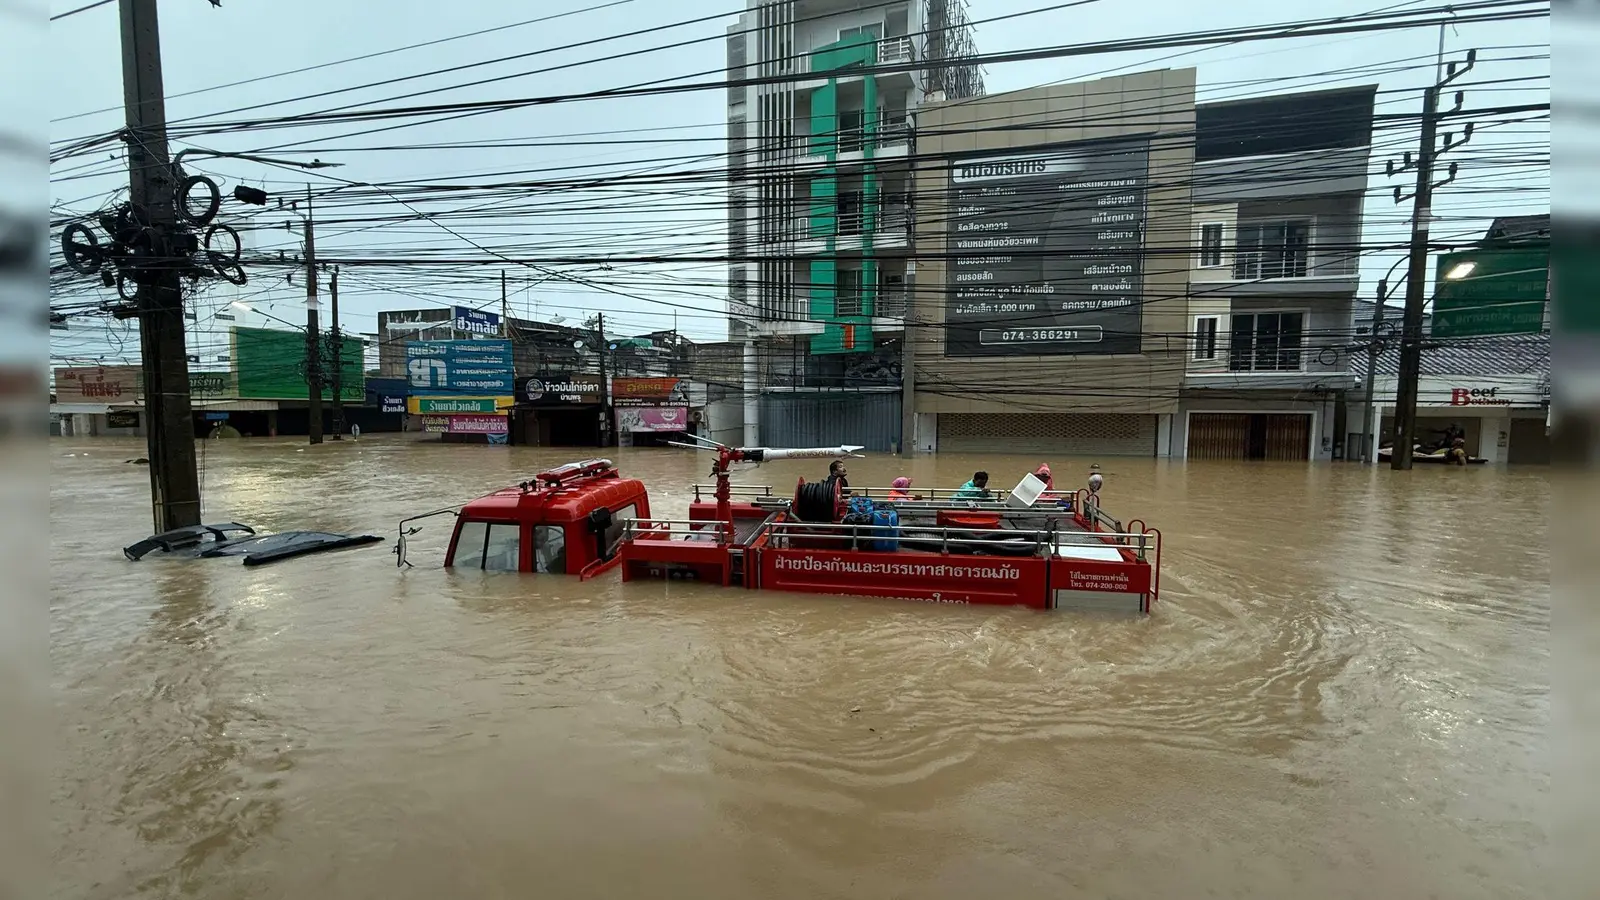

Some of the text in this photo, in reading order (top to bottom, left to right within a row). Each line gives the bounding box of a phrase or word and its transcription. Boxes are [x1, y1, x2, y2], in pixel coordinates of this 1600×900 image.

[1083, 264, 1132, 275] เสริมหน้าอก
[956, 271, 994, 281] ลบรอยสัก
[994, 304, 1017, 313] 1,000
[1019, 303, 1036, 312] บาท
[1002, 330, 1079, 340] 074-366291
[408, 358, 448, 388] ยา
[1450, 387, 1500, 406] Beef
[775, 555, 1020, 580] ฝ่ายป้องกันและบรรเทาสาธารณภัย
